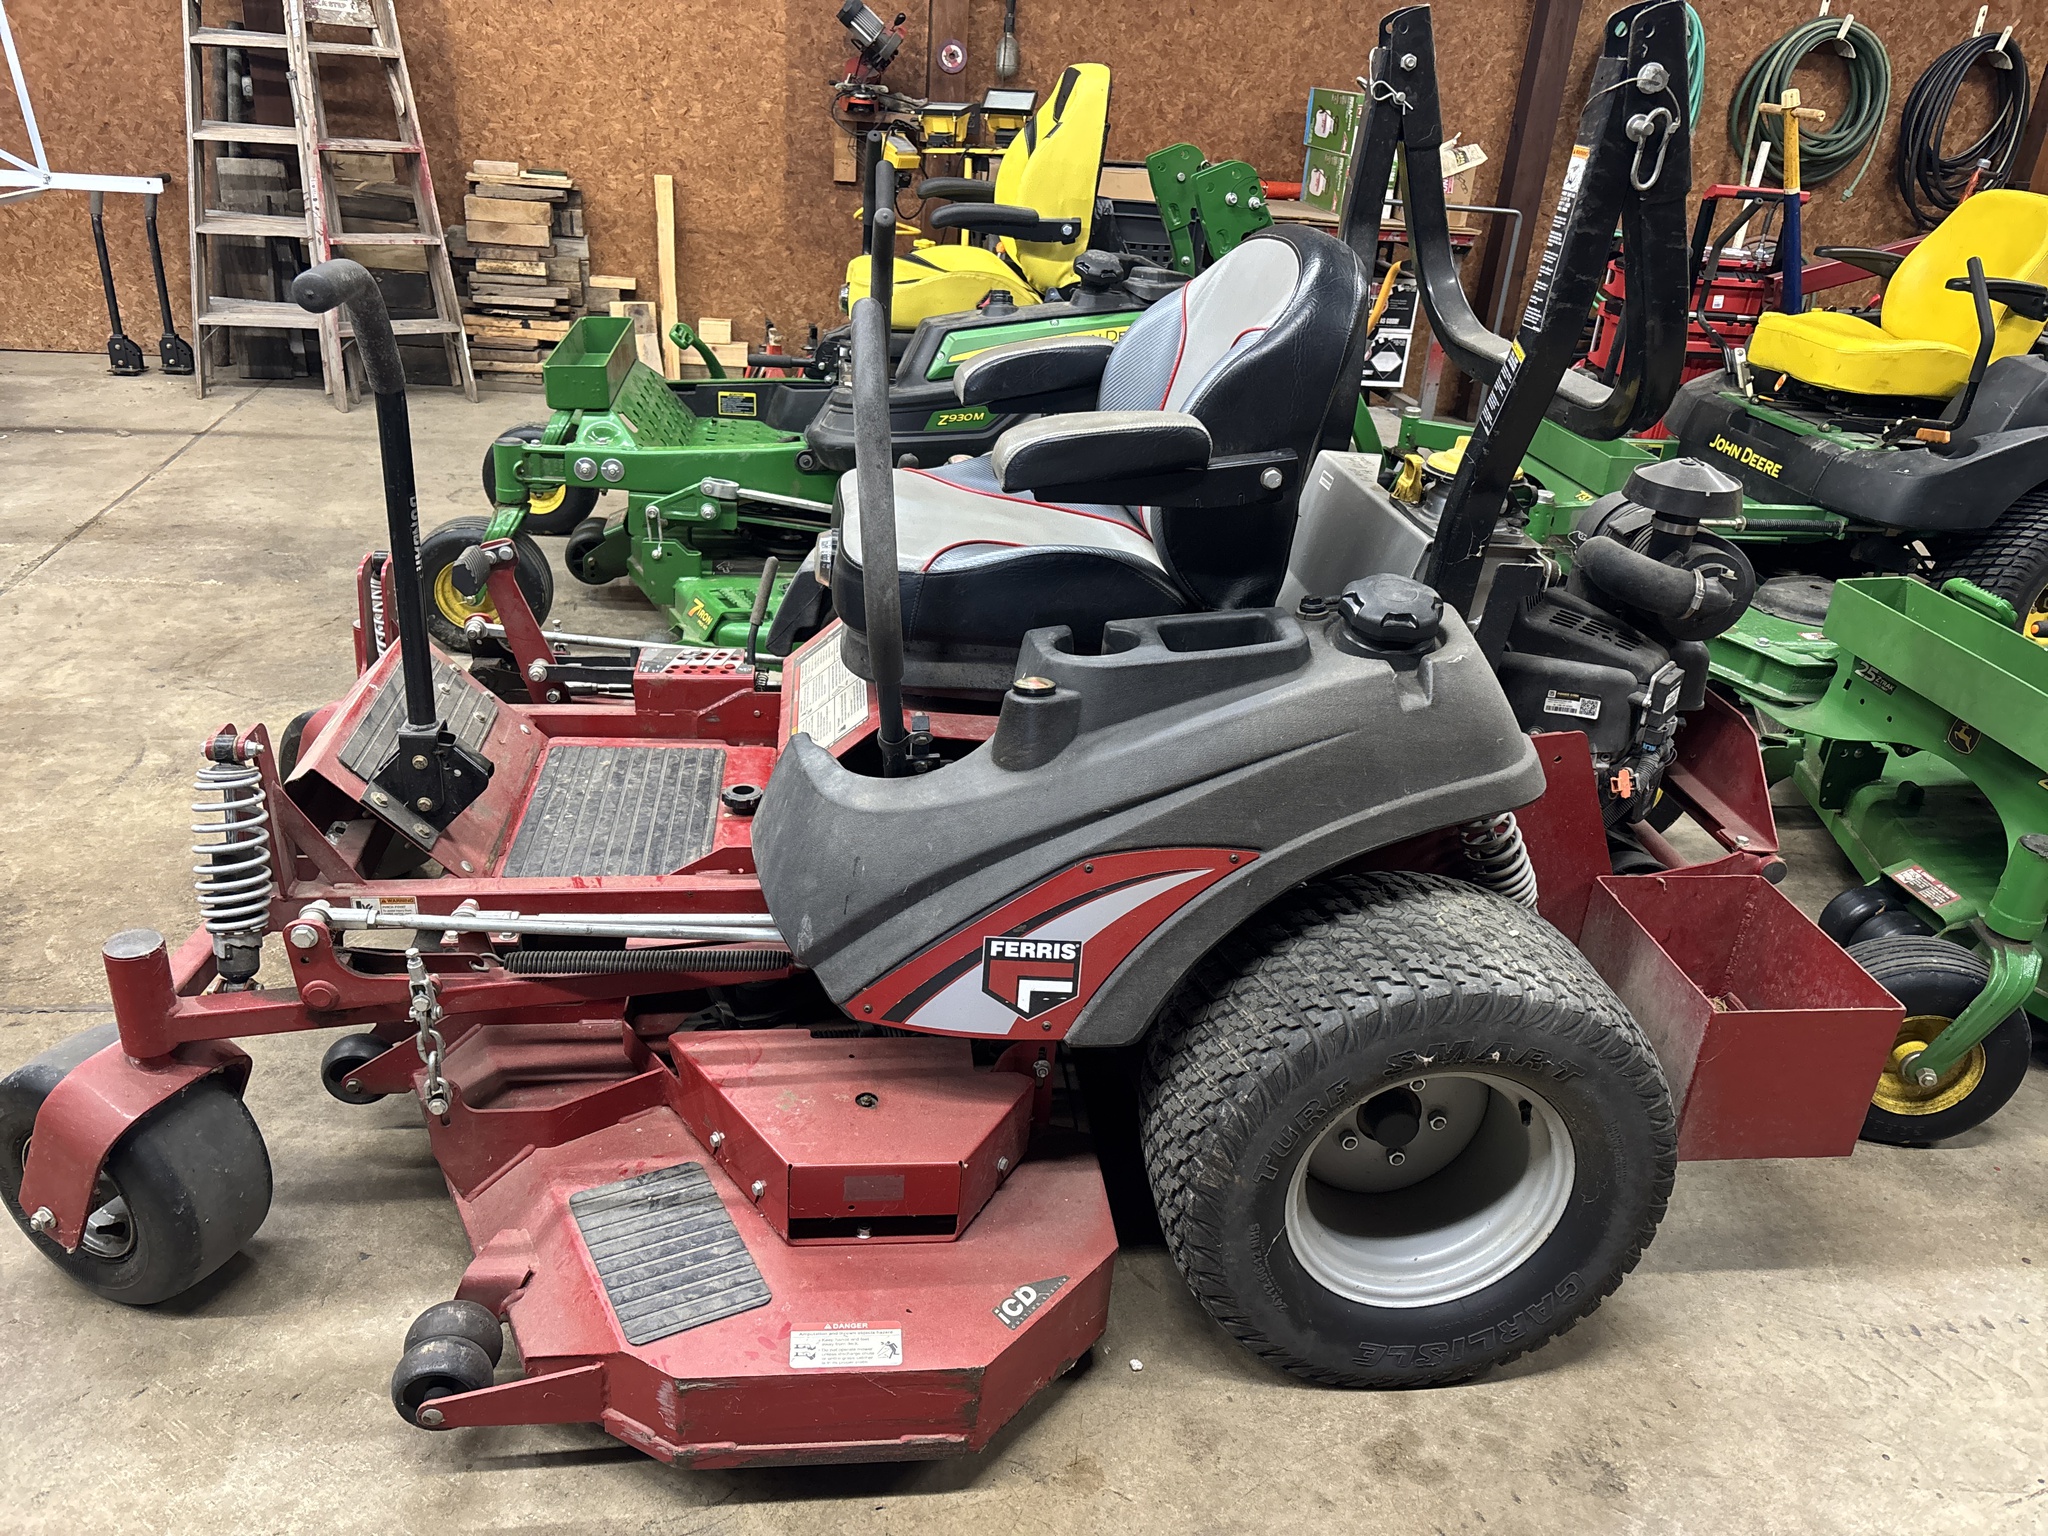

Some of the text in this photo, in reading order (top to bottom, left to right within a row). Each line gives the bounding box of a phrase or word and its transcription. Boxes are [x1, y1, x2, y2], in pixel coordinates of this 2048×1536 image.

[937, 412, 985, 426] Z930M
[1709, 434, 1783, 478] JOHN DEERE
[1854, 661, 1880, 682] 25
[990, 941, 1077, 960] FERRIS
[1383, 1040, 1588, 1082] SMART
[1252, 1077, 1350, 1184] TURF
[994, 1286, 1037, 1325] iCD
[1352, 1271, 1586, 1367] CARLISLE
